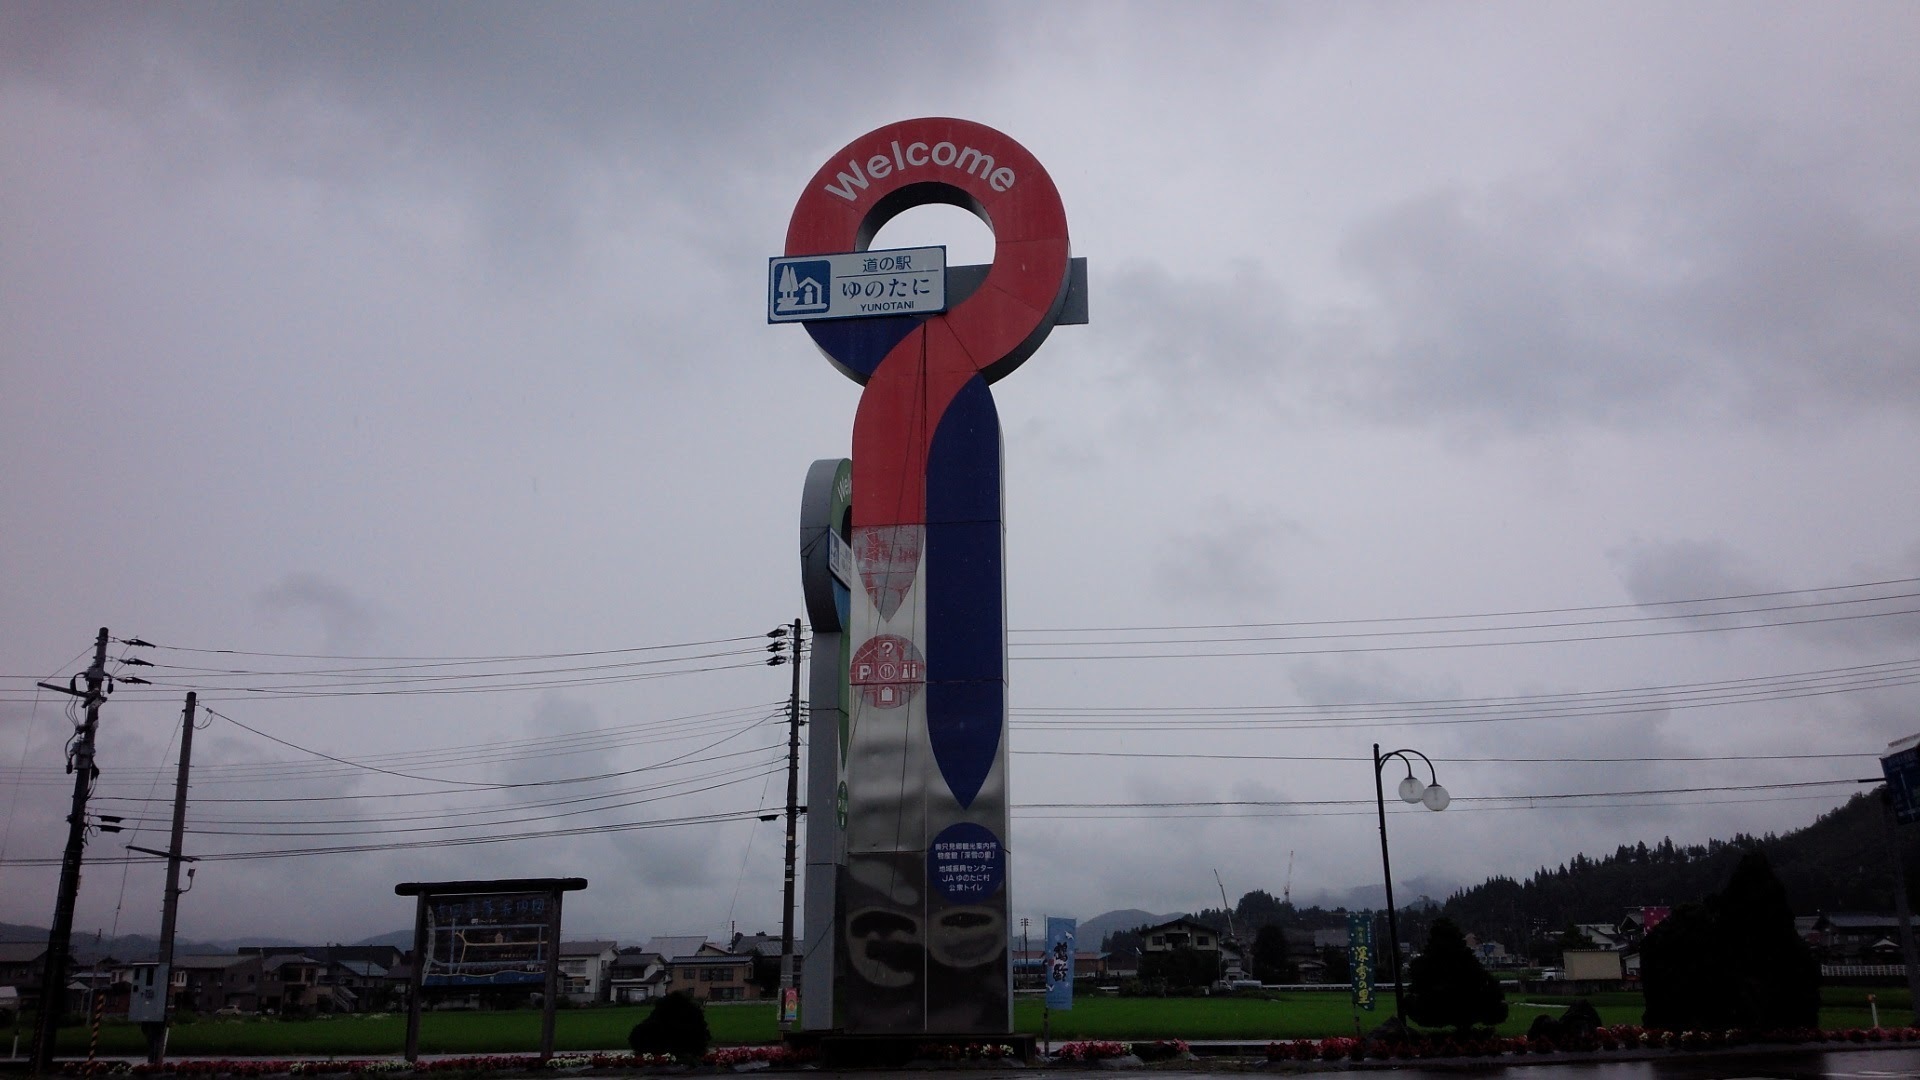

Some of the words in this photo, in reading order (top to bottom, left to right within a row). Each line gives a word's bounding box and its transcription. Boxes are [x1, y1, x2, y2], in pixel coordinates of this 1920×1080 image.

[824, 140, 1016, 202] Welcome
[862, 255, 912, 273] 道の駅
[842, 278, 931, 300] ゆのたに
[860, 300, 915, 312] YUNOTANI
[942, 874, 955, 882] JA
[948, 884, 983, 892] 公衆トイレ
[1355, 945, 1370, 1003] 深雪の里
